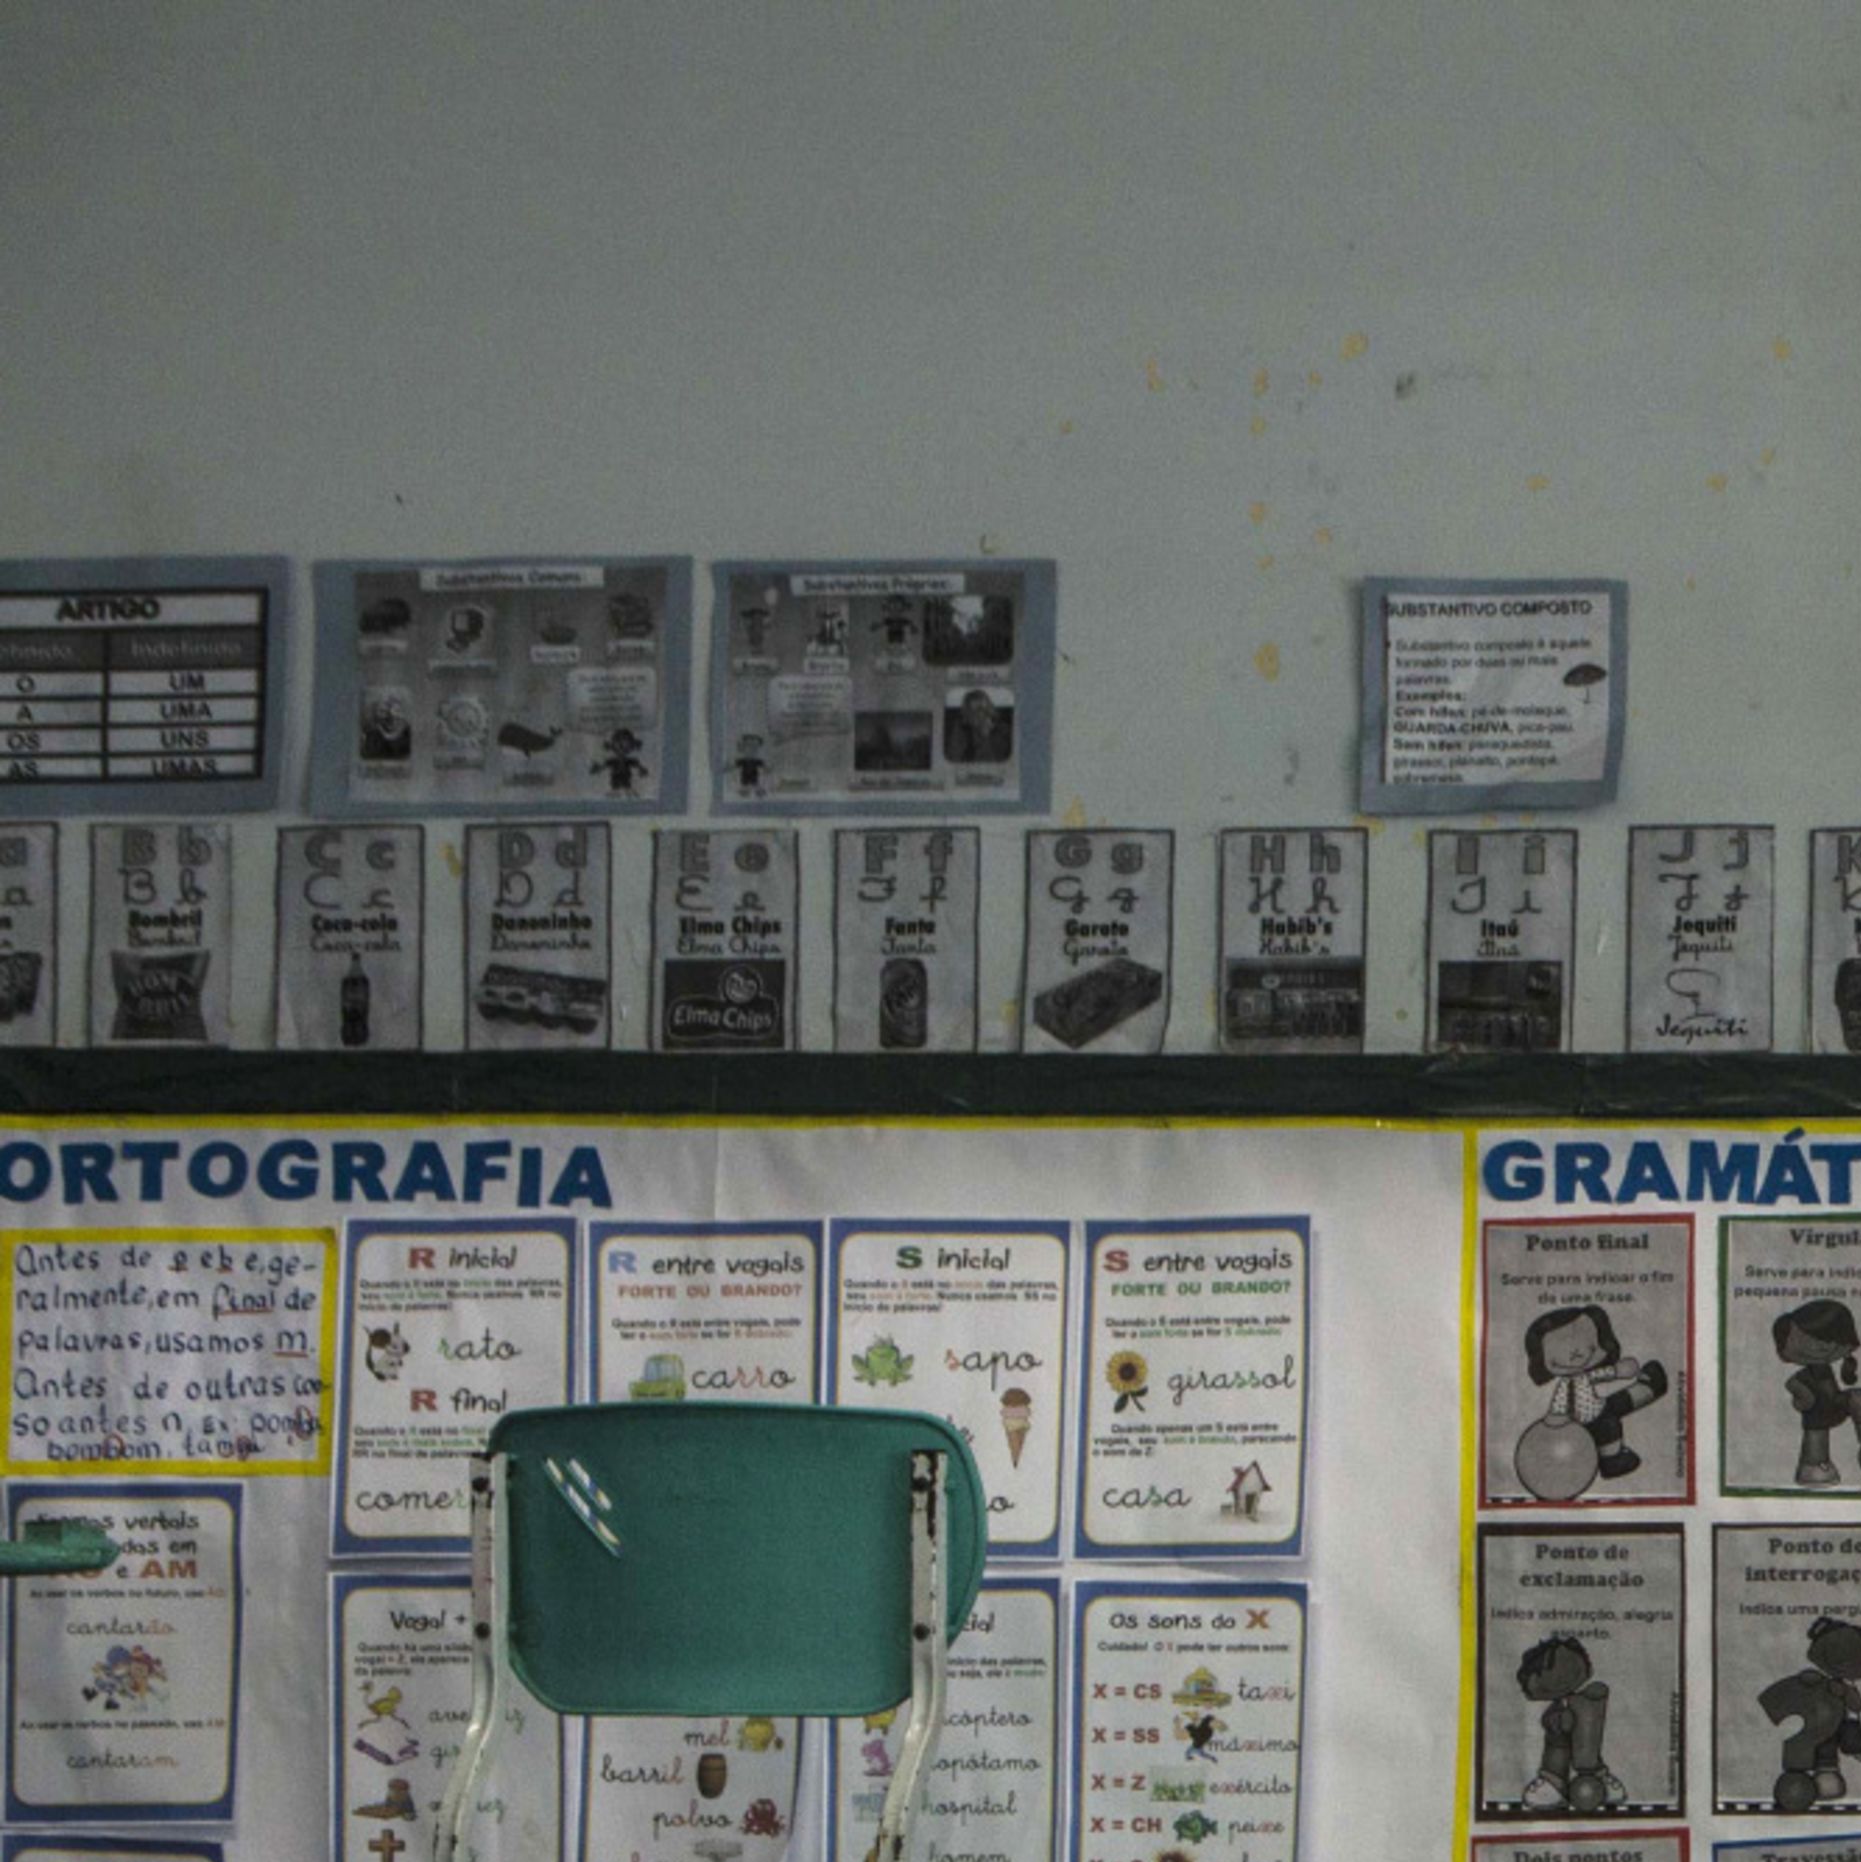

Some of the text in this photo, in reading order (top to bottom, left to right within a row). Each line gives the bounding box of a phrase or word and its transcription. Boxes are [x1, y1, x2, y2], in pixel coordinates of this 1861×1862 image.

[57, 600, 160, 621] ARTIGO
[1500, 601, 1592, 616] COMPOSTO
[16, 676, 205, 692] O UM
[17, 703, 212, 720] A UMA
[7, 731, 209, 750] OS UNS
[8, 760, 39, 777] AS
[130, 910, 202, 929] Bombril
[313, 914, 397, 932] Coca-cola
[491, 912, 591, 932] Danoninho
[679, 917, 781, 937] Elma Chips
[885, 918, 936, 935] Fanta
[1064, 918, 1129, 937] Garoto
[1259, 918, 1332, 937] Habib's
[1480, 919, 1519, 938] Itaú
[1672, 915, 1738, 936] Jequiti
[673, 1006, 772, 1030] Elma Chips
[1655, 1016, 1748, 1042] Jequiti
[0, 1139, 611, 1208] ORTOGRAFIA
[1526, 1233, 1648, 1252] Ponto final
[15, 1243, 152, 1276] Antes de
[409, 1245, 517, 1268] R inicial
[608, 1251, 804, 1275] R entre vogais
[898, 1246, 1010, 1270] S inicial
[1102, 1248, 1292, 1275] S entre vogais
[618, 1283, 802, 1300] FORTE OU BRANDO?
[1111, 1280, 1292, 1298] FORTE OU BRANDO?
[212, 1281, 316, 1322] final de
[439, 1327, 519, 1361] rato
[691, 1364, 796, 1390] carro
[945, 1349, 1042, 1391] sapo
[1167, 1353, 1297, 1407] girassol
[12, 1367, 286, 1401] Antes de outras
[410, 1389, 509, 1414] R final
[1102, 1482, 1193, 1510] casa
[1536, 1544, 1629, 1562] Ponto de
[1768, 1537, 1832, 1558] Ponto
[141, 1559, 198, 1579] AM
[1519, 1570, 1644, 1590] exclamação
[1109, 1609, 1270, 1631] Os sons do X
[1092, 1681, 1161, 1701] X CS
[685, 1722, 730, 1747] mel
[1090, 1727, 1159, 1745] X SS
[653, 1808, 731, 1843] polvo
